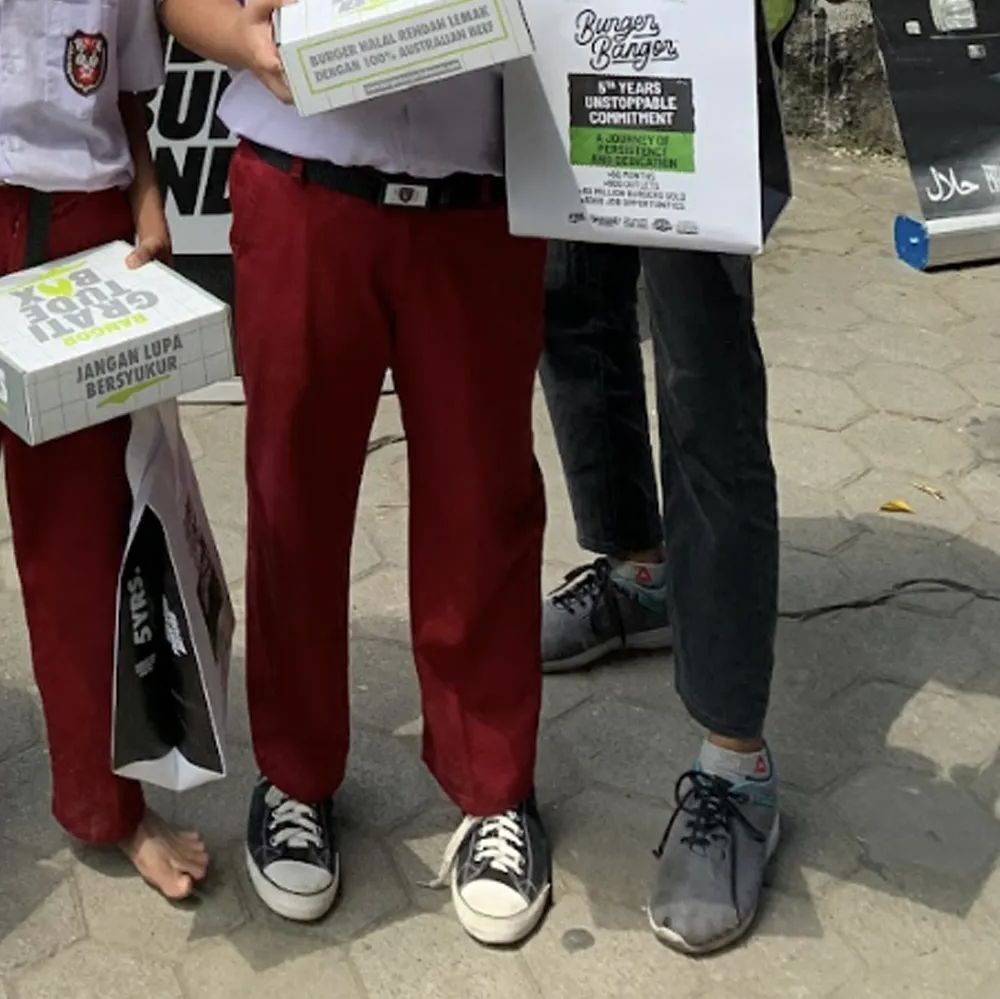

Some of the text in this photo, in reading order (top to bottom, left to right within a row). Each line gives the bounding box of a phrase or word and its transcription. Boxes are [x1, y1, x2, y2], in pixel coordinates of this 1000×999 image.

[309, 4, 491, 68] BURGER HALAL RENDAH LEMAK
[574, 8, 661, 46] Burger
[313, 56, 362, 83] DENGAN
[363, 49, 397, 69] 100%
[397, 28, 469, 58] AUSTRALIAN
[468, 20, 495, 38] BEEF
[589, 34, 681, 72] Bangor
[584, 95, 678, 110] UNSTOPPABLE
[618, 80, 662, 95] YEARS
[588, 111, 675, 125] COMMITMENT
[925, 165, 980, 202] حلال
[62, 314, 149, 348] BANGOR
[76, 334, 184, 384] JANGAN LUPA
[85, 355, 179, 400] BERSYUKUR
